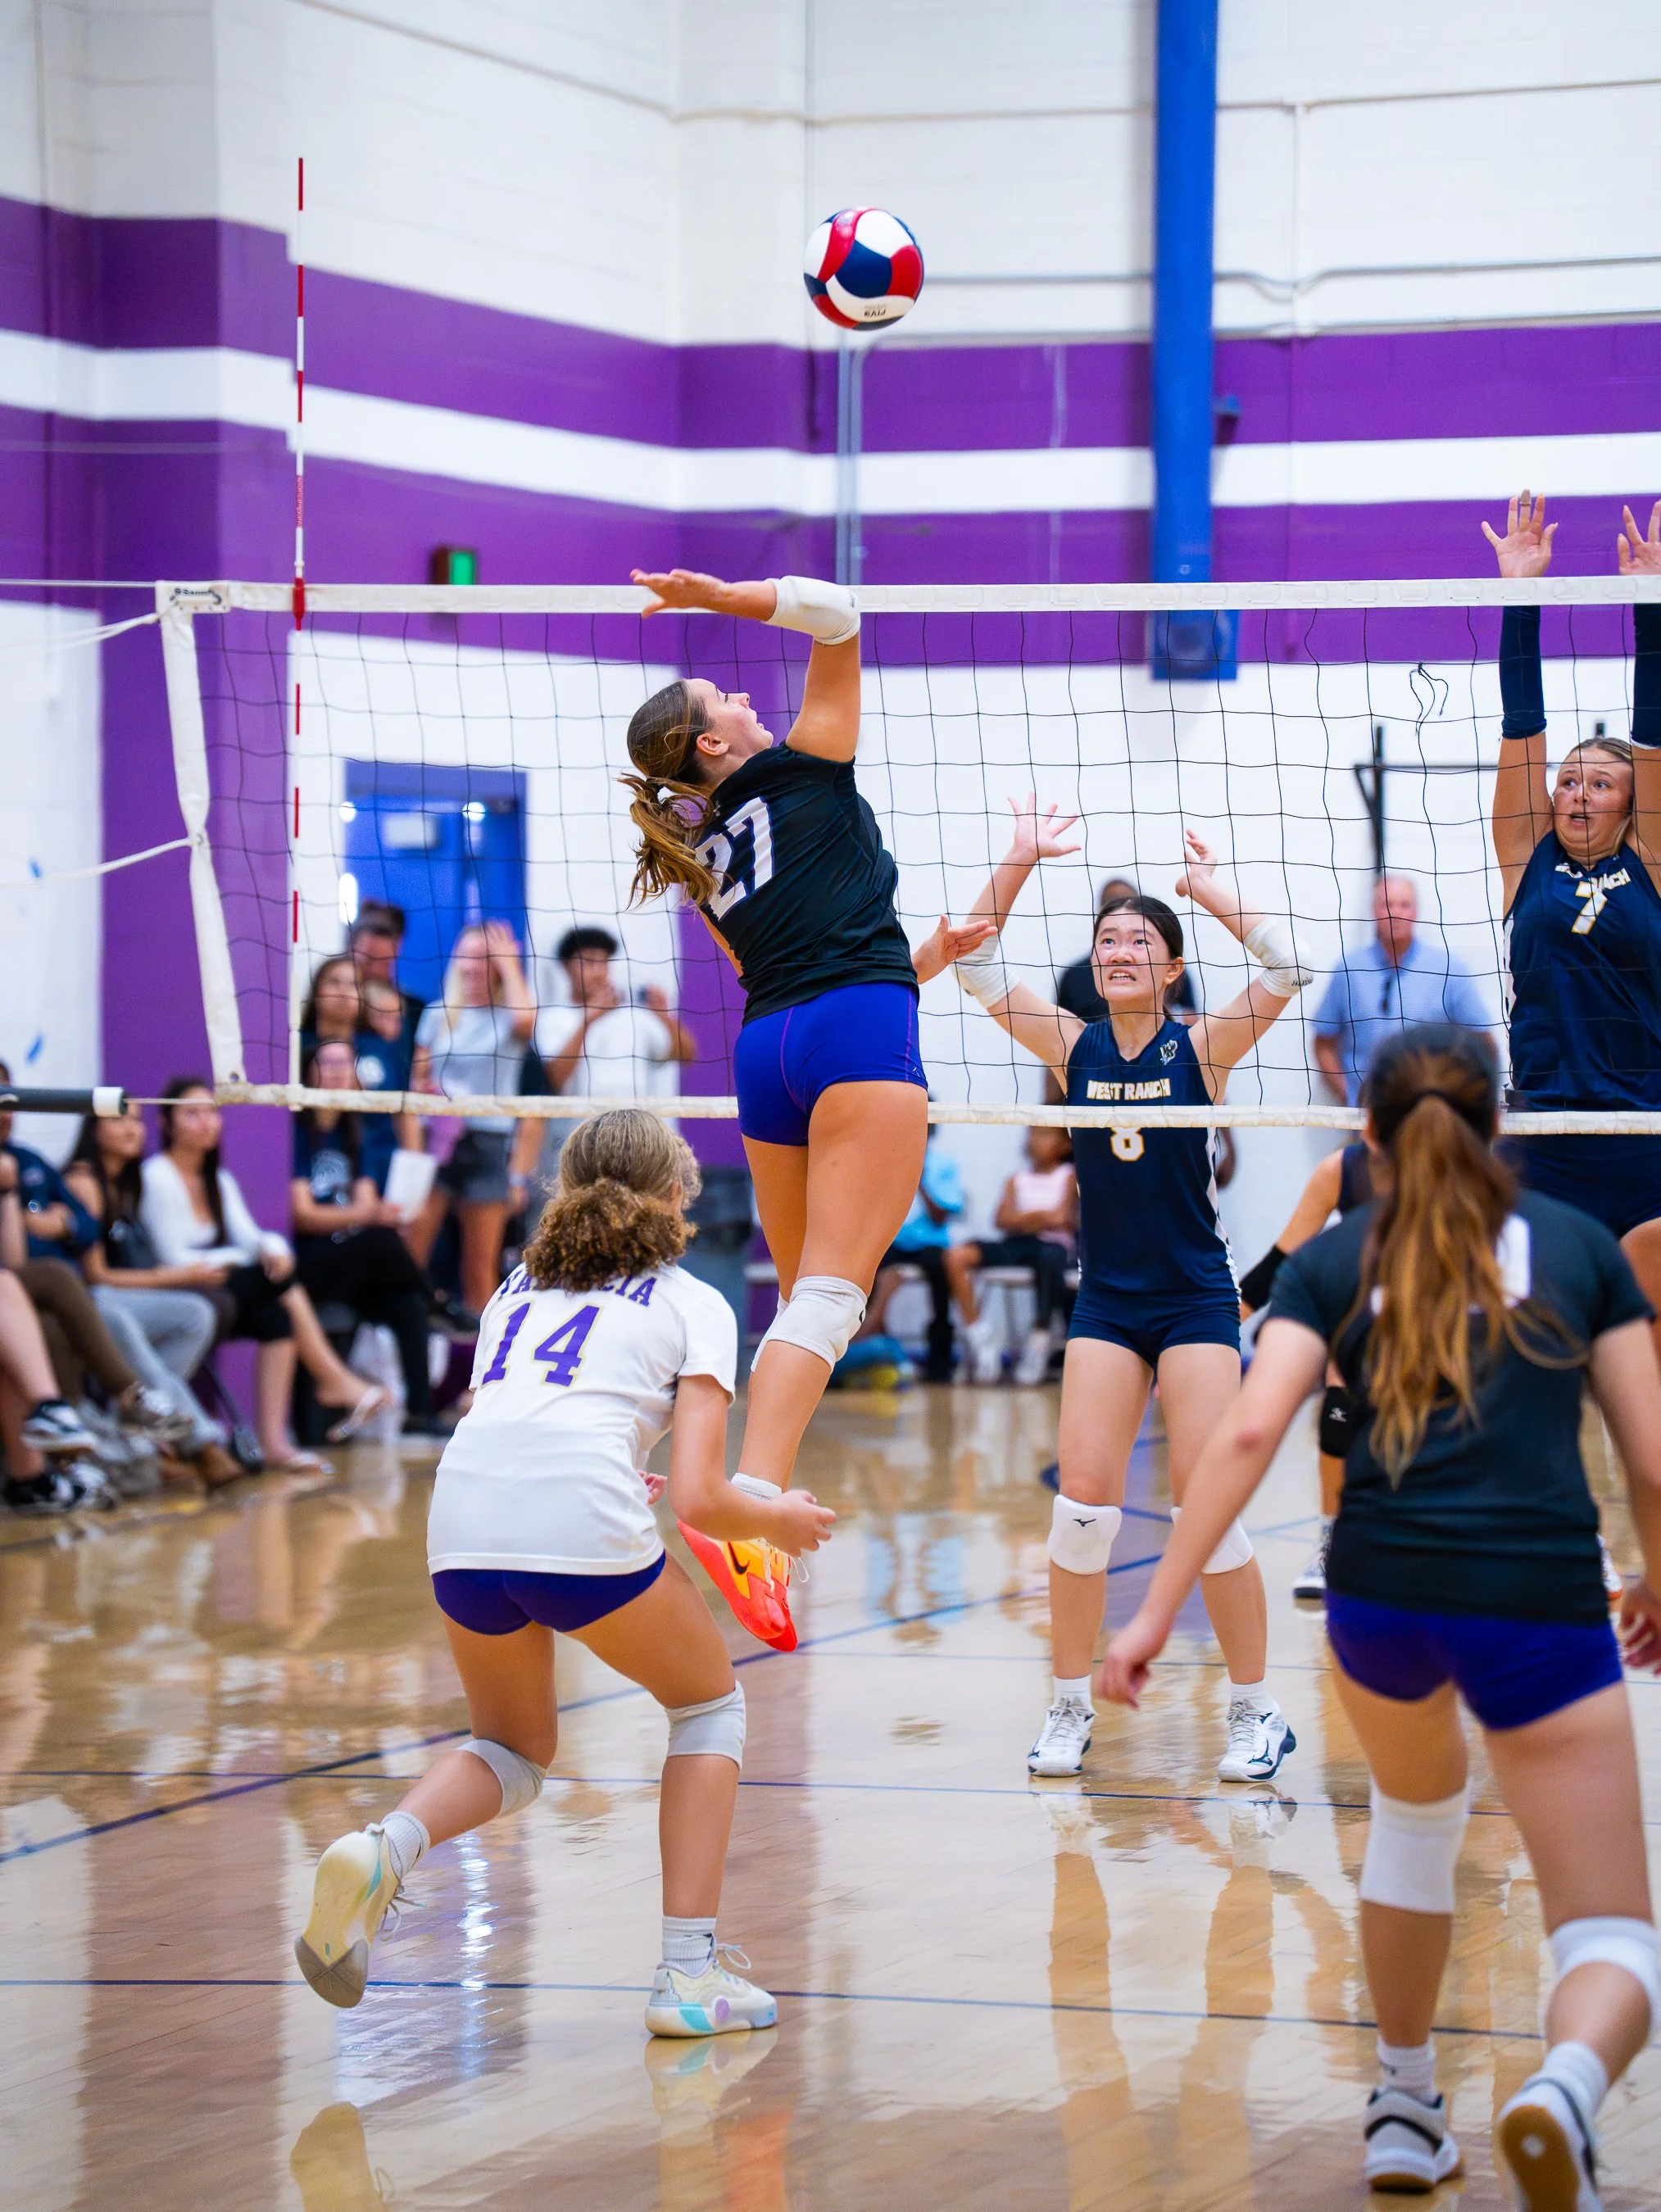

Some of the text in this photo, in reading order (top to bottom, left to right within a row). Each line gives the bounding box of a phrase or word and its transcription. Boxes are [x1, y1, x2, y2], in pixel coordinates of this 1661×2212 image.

[695, 796, 773, 922] 27
[1571, 881, 1609, 936] 7
[1087, 1077, 1171, 1101] WEST RANCH
[481, 1301, 602, 1388] 14
